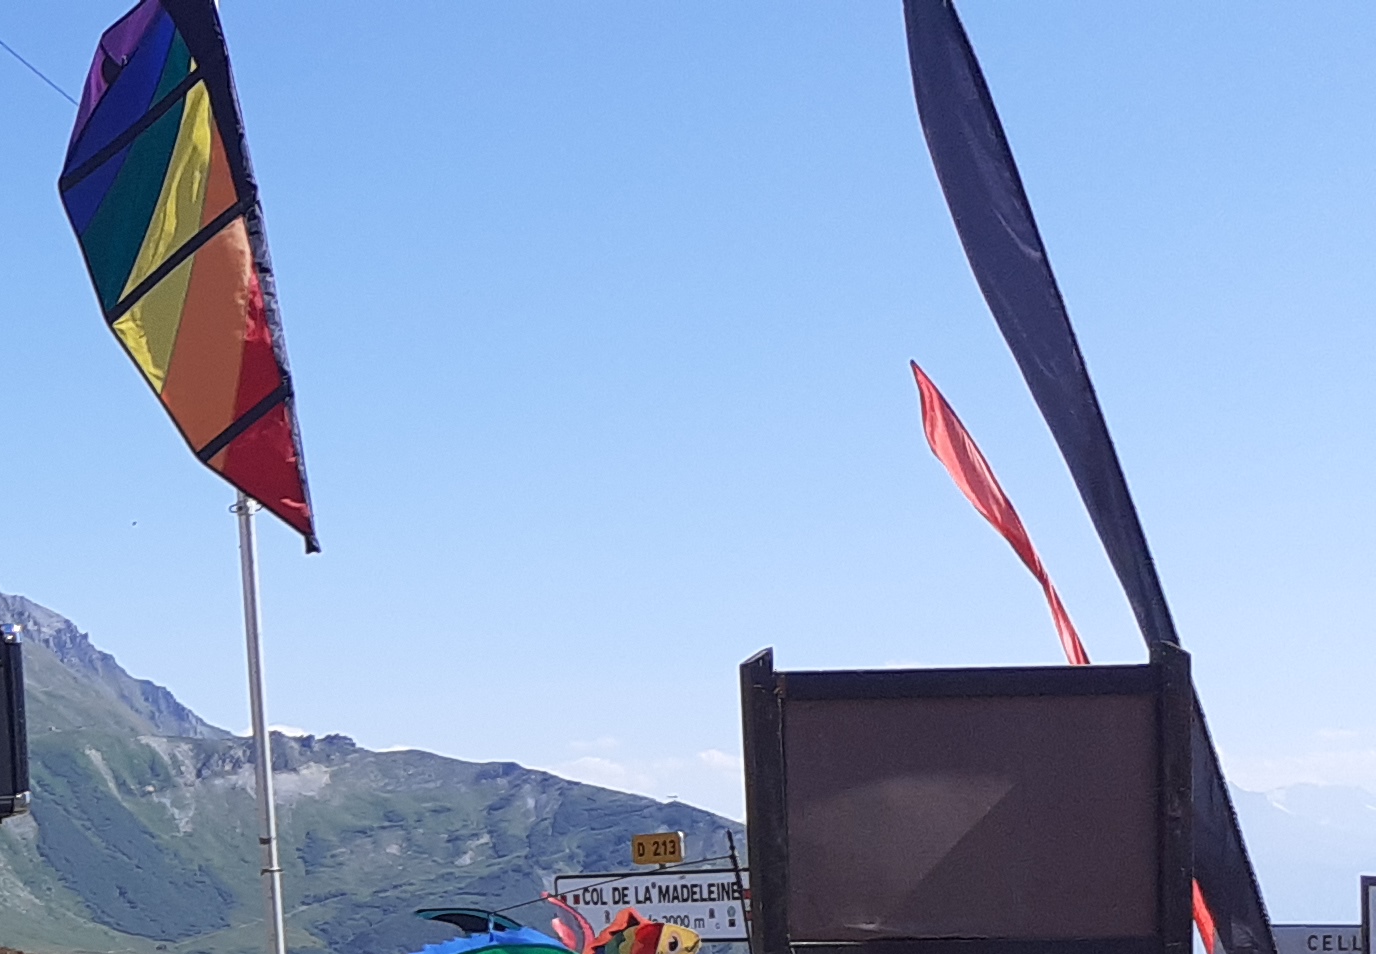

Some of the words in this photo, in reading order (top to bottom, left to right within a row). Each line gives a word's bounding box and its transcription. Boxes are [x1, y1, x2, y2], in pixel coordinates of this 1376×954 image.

[638, 842, 645, 857] D
[652, 839, 676, 856] 213
[582, 887, 607, 906] COL
[612, 886, 630, 905] DE
[635, 885, 653, 904] LA
[658, 882, 741, 903] MADELEINE
[694, 917, 705, 929] m
[1307, 934, 1362, 951] CELL
